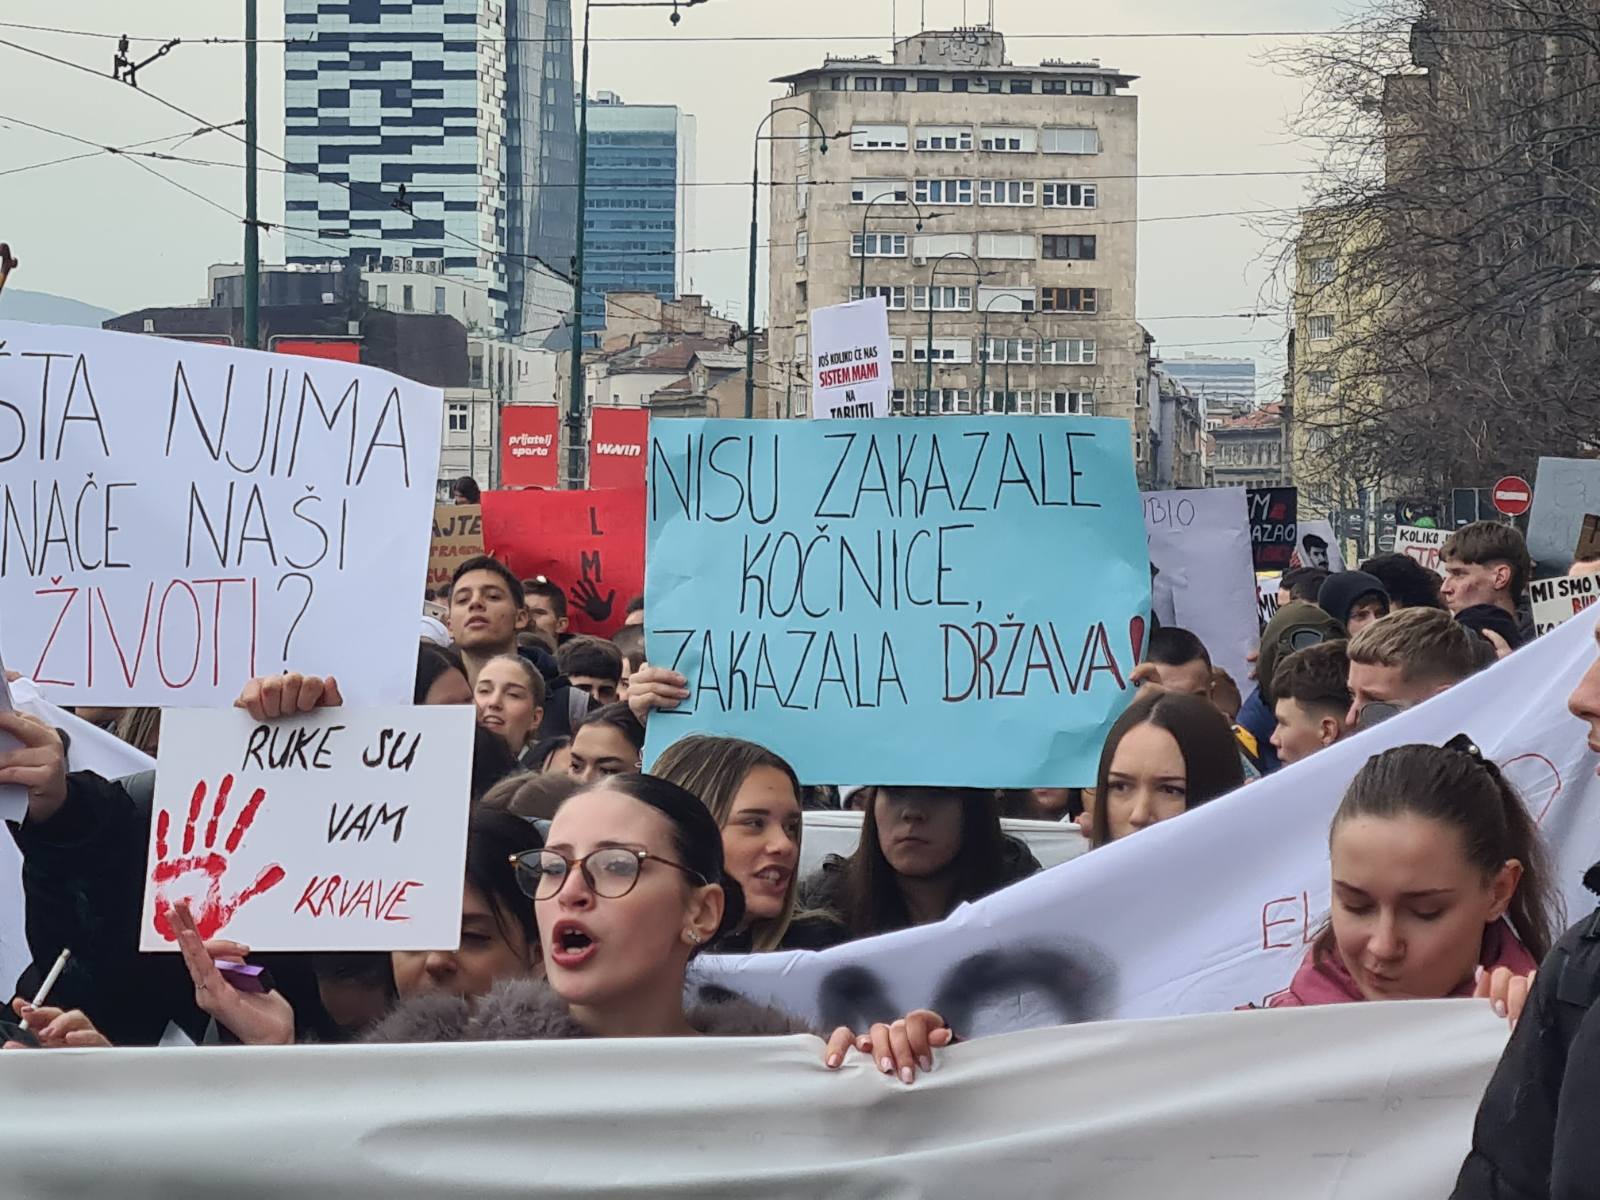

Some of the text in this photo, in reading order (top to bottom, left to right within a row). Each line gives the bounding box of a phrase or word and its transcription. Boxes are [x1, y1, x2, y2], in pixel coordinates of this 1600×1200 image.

[830, 350, 852, 364] KOLIKO
[864, 346, 877, 358] NAS
[819, 362, 878, 387] SISTEM MAMI
[845, 390, 856, 402] NA
[166, 360, 410, 488] NJIMA
[508, 434, 552, 446] prijatelj
[512, 446, 548, 457] sporta
[652, 431, 1101, 524] NISU ZAKAZALE
[590, 507, 603, 535] L
[1246, 491, 1271, 520] M
[186, 481, 348, 571] NAŠI
[1400, 529, 1439, 544] KOLIKO
[740, 525, 983, 619] KOČNICE,
[1531, 581, 1554, 603] MI
[1558, 577, 1591, 597] SMO
[32, 573, 314, 689] ŽIVOTI?
[652, 613, 1146, 715] ZAKAZALA DRŽAVA!
[242, 724, 421, 772] RUKE SU
[328, 802, 408, 843] VAM
[294, 875, 424, 921] KRVAVE
